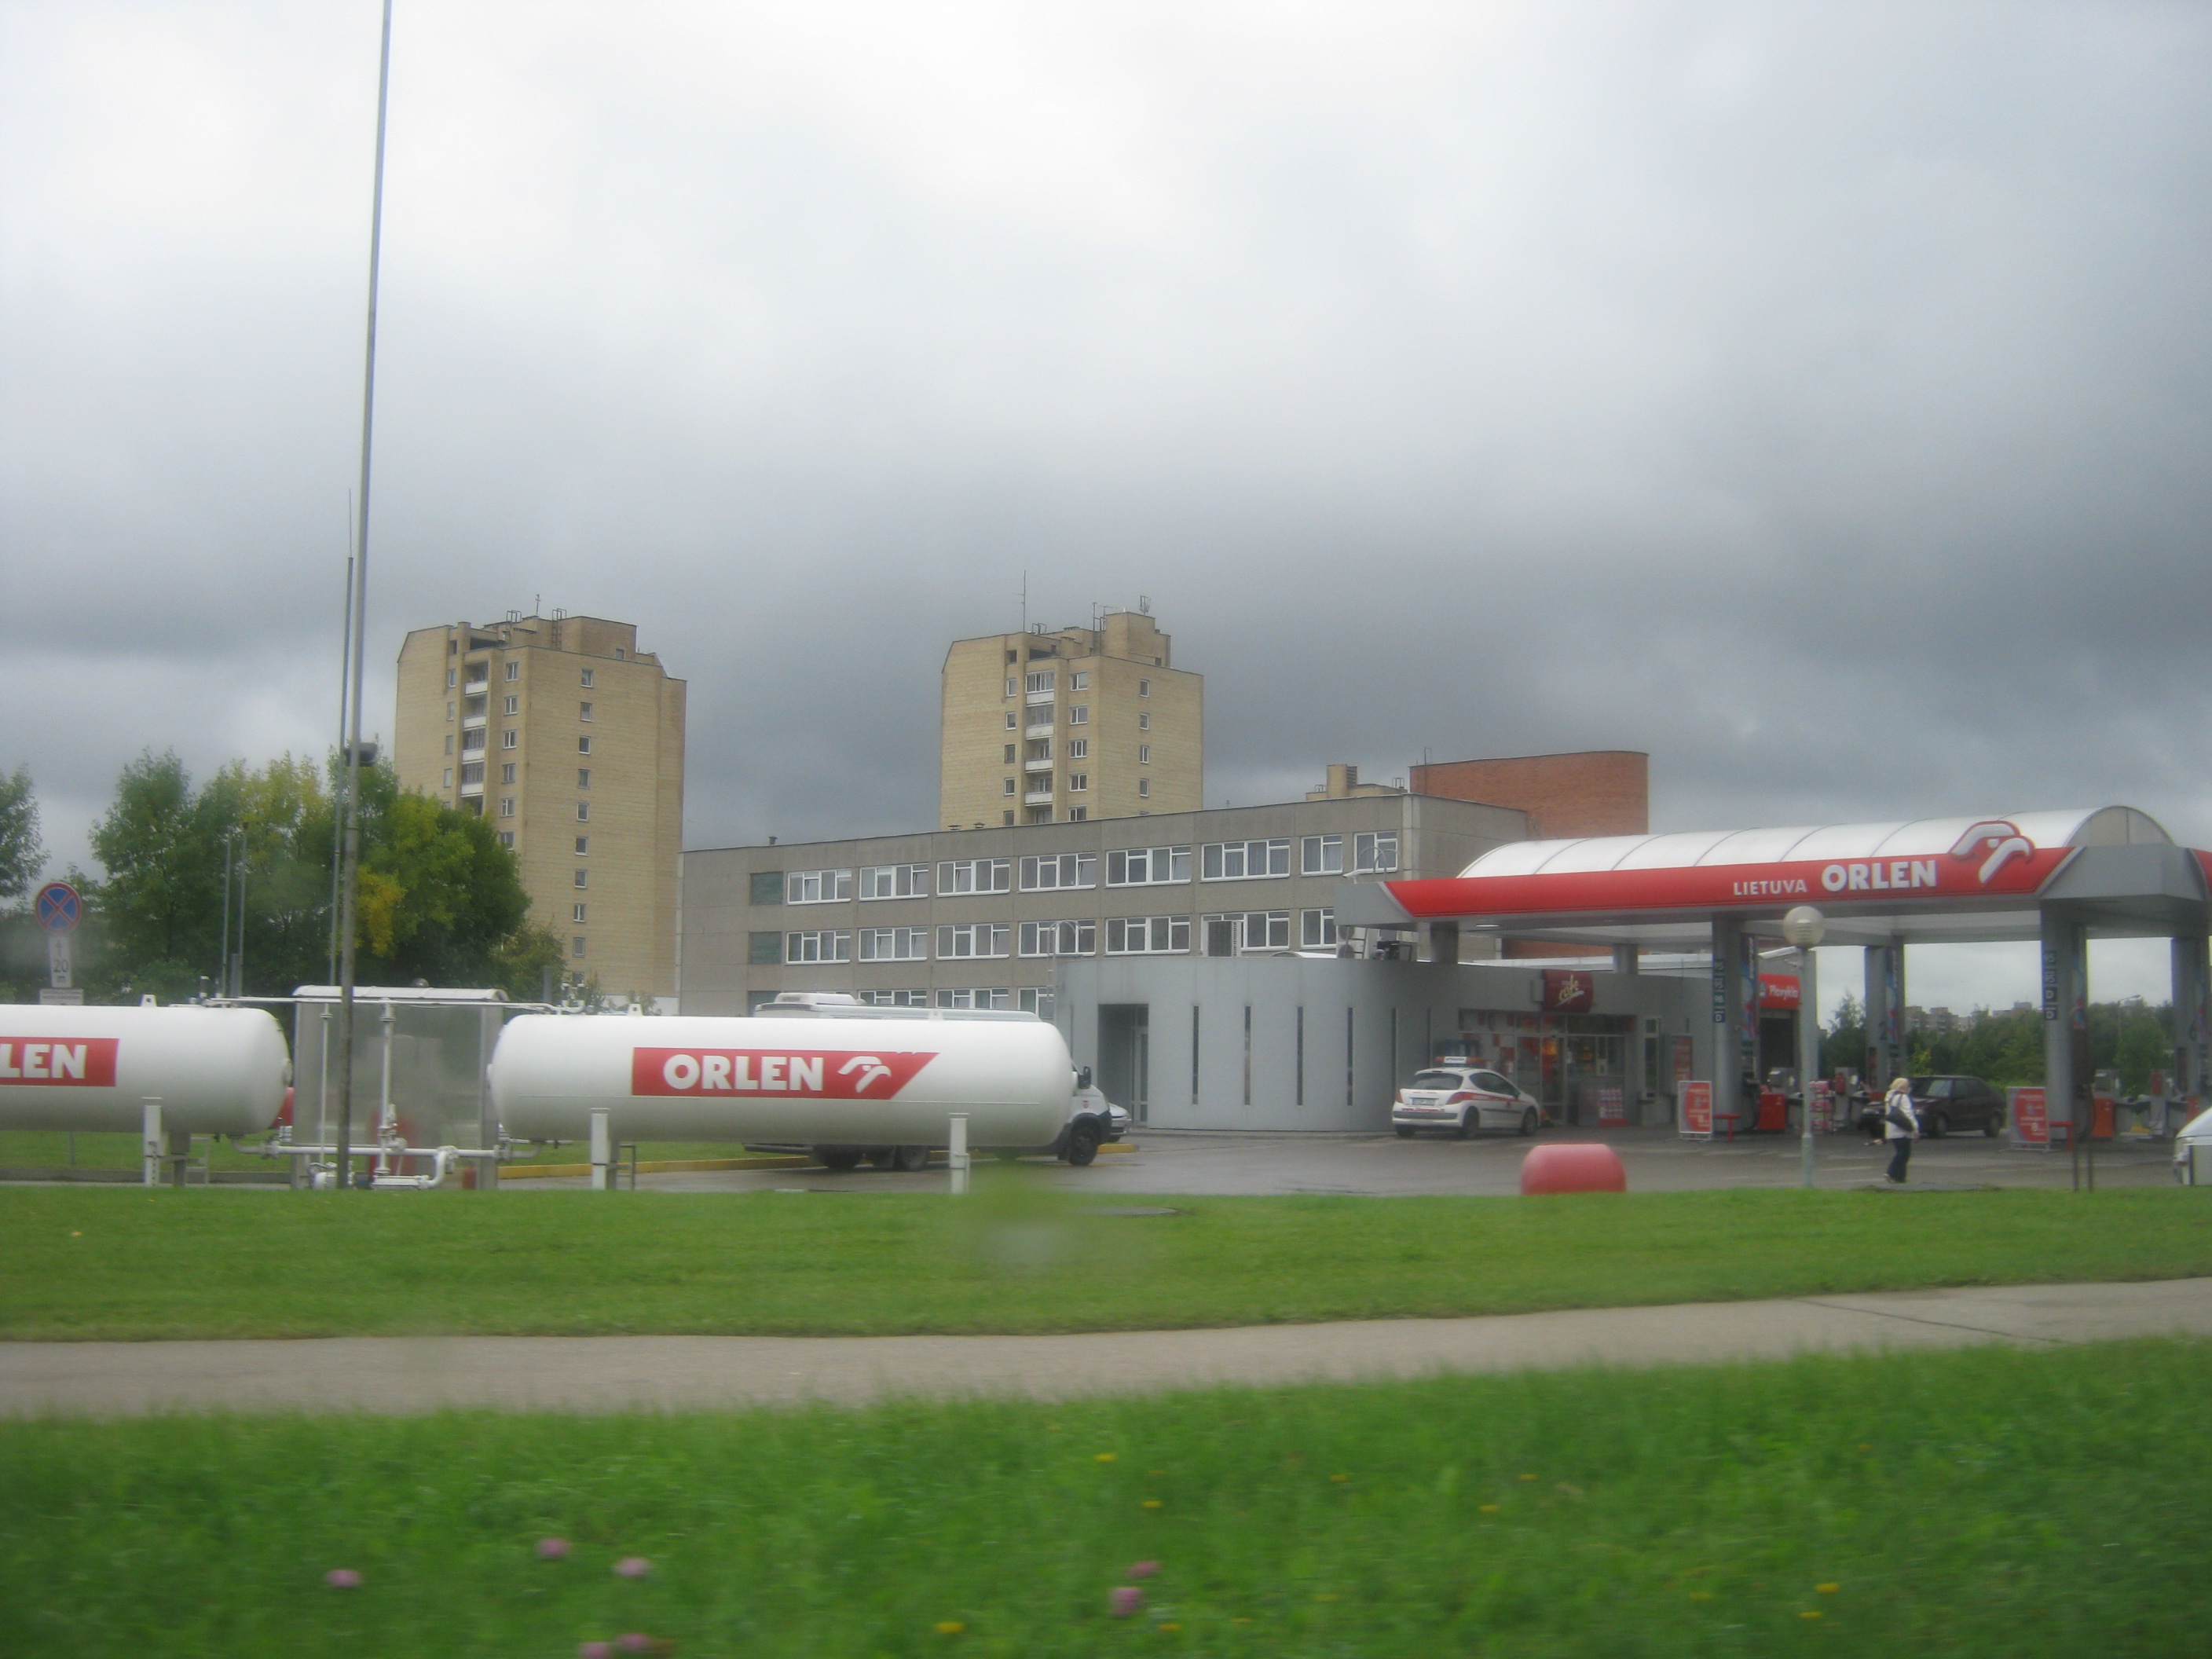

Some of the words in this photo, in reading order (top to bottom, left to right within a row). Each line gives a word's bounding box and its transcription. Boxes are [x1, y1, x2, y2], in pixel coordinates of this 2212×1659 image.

[1734, 879, 1808, 896] LIETUVA
[1822, 860, 1937, 892] ORLEN
[53, 959, 69, 972] 20
[2045, 990, 2054, 999] D
[2045, 1010, 2054, 1020] D
[663, 1053, 824, 1091] ORLEN
